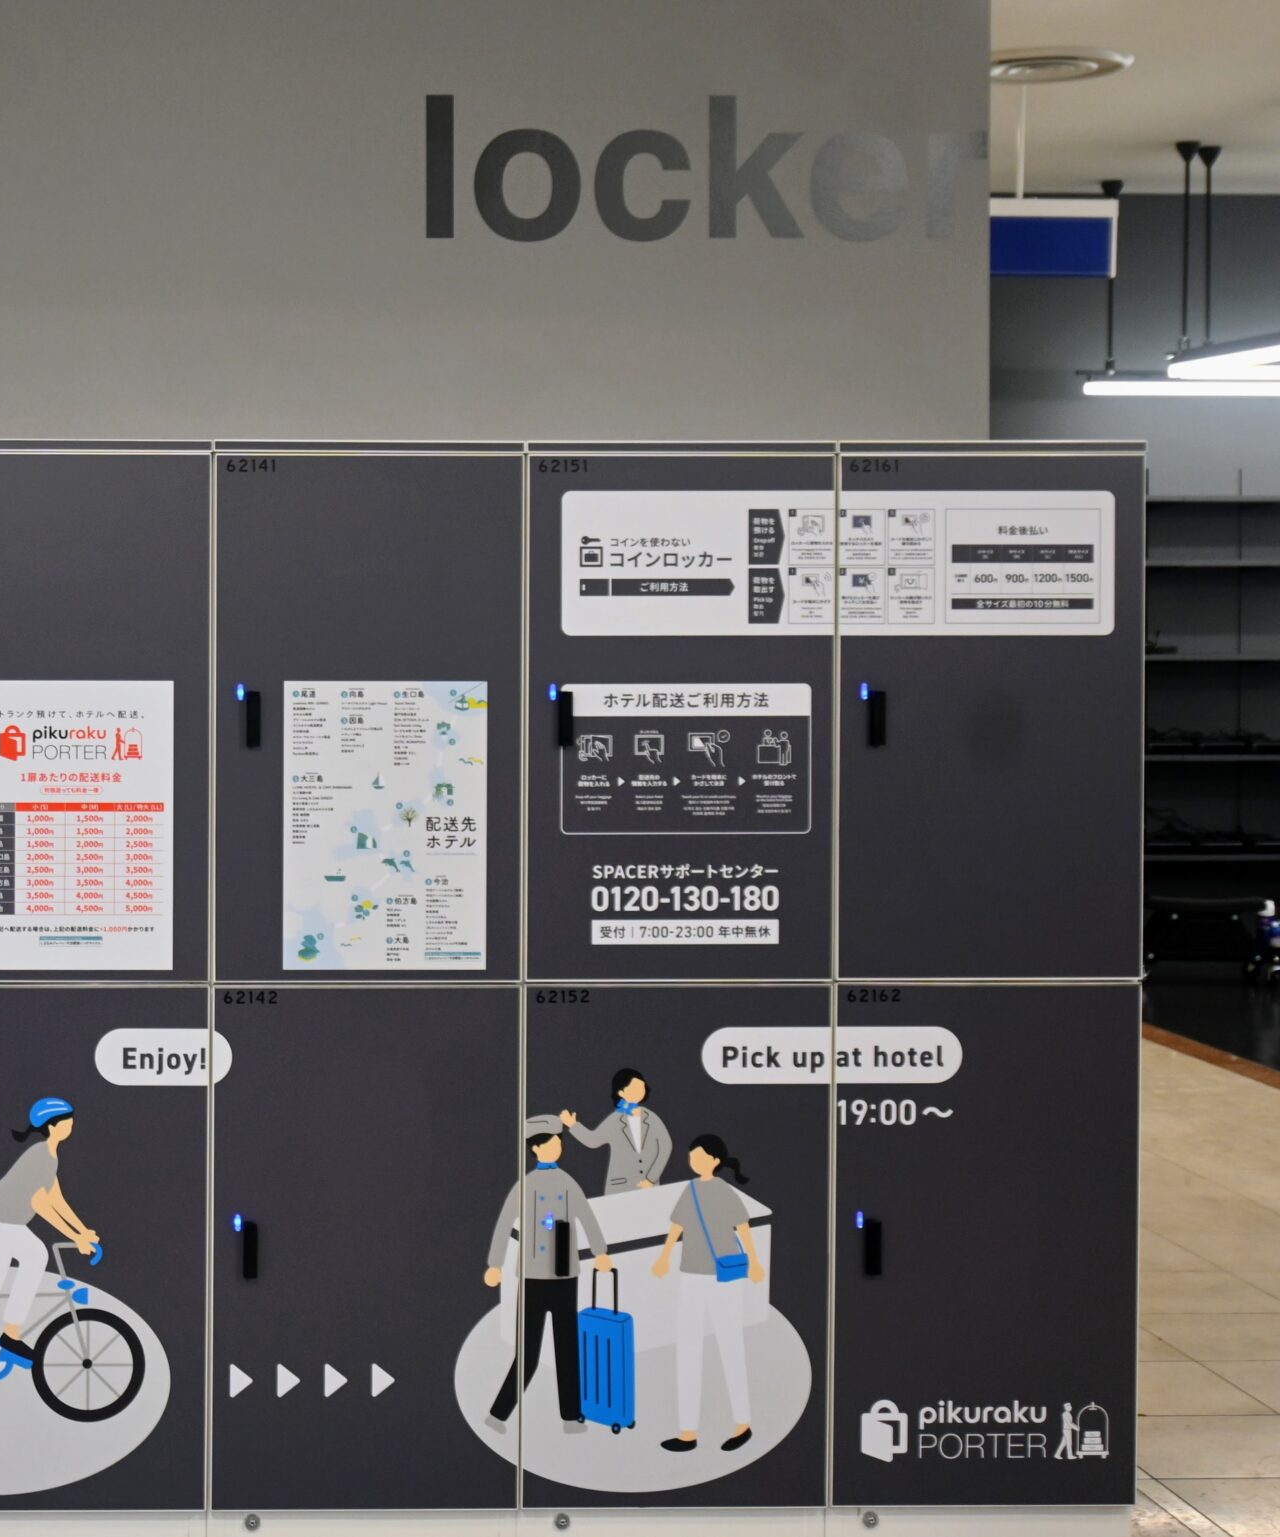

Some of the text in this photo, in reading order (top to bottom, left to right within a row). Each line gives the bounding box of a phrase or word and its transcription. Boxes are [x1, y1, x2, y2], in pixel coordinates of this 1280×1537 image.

[424, 93, 988, 242] locker
[225, 458, 277, 472] 62141
[538, 458, 589, 472] 62151
[849, 458, 900, 472] 62161
[998, 526, 1048, 535] 料金後払い
[611, 537, 690, 547] コインを使わない
[610, 552, 732, 568] コインロッカー
[640, 582, 688, 592] ご利用方法
[975, 599, 1070, 609] 全サイズ最初の10分無料
[604, 692, 768, 708] ホテル配送ご利用方法
[0, 710, 144, 719] トランク預けて、ホテルへ配送。
[32, 725, 107, 742] pikuraku
[32, 745, 106, 760] PORTER
[21, 772, 121, 782] 1扉あたりの配送料金
[26, 815, 54, 823] 1,000円
[76, 815, 104, 823] 1,500円
[126, 815, 153, 823] 2,000円
[426, 816, 477, 832] 配送先
[26, 828, 54, 836] 1,000円
[76, 828, 104, 836] 1,500円
[126, 828, 153, 836] 2,000円
[26, 841, 54, 849] 1,500円
[76, 841, 104, 849] 2,000円
[126, 841, 153, 849] 2,500円
[427, 834, 477, 849] ホテル
[26, 853, 54, 862] 2,000円
[76, 853, 104, 862] 2,500円
[126, 853, 153, 862] 3,000円
[26, 866, 54, 875] 2,500円
[76, 866, 104, 875] 3,000円
[126, 866, 153, 875] 3,500円
[593, 864, 778, 879] SPACERサポートセンター
[26, 879, 54, 888] 3,000円
[76, 879, 104, 888] 3,500円
[126, 879, 153, 888] 4,000円
[26, 892, 54, 901] 3,500円
[76, 892, 104, 901] 4,000円
[126, 892, 153, 901] 4,500円
[591, 885, 779, 911] 0120-130-180
[26, 905, 54, 913] 4,000円
[76, 905, 104, 913] 4,500円
[126, 905, 153, 913] 5,000円
[600, 926, 770, 938] 受付 7:00-23:00 年中無休
[224, 991, 277, 1004] 62142
[536, 989, 590, 1003] 62152
[847, 988, 901, 1003] 62162
[121, 1047, 208, 1077] Enjoy!
[723, 1045, 944, 1074] Pick up at hotel
[919, 1400, 1046, 1428] pikuraku
[918, 1433, 1046, 1459] PORTER
